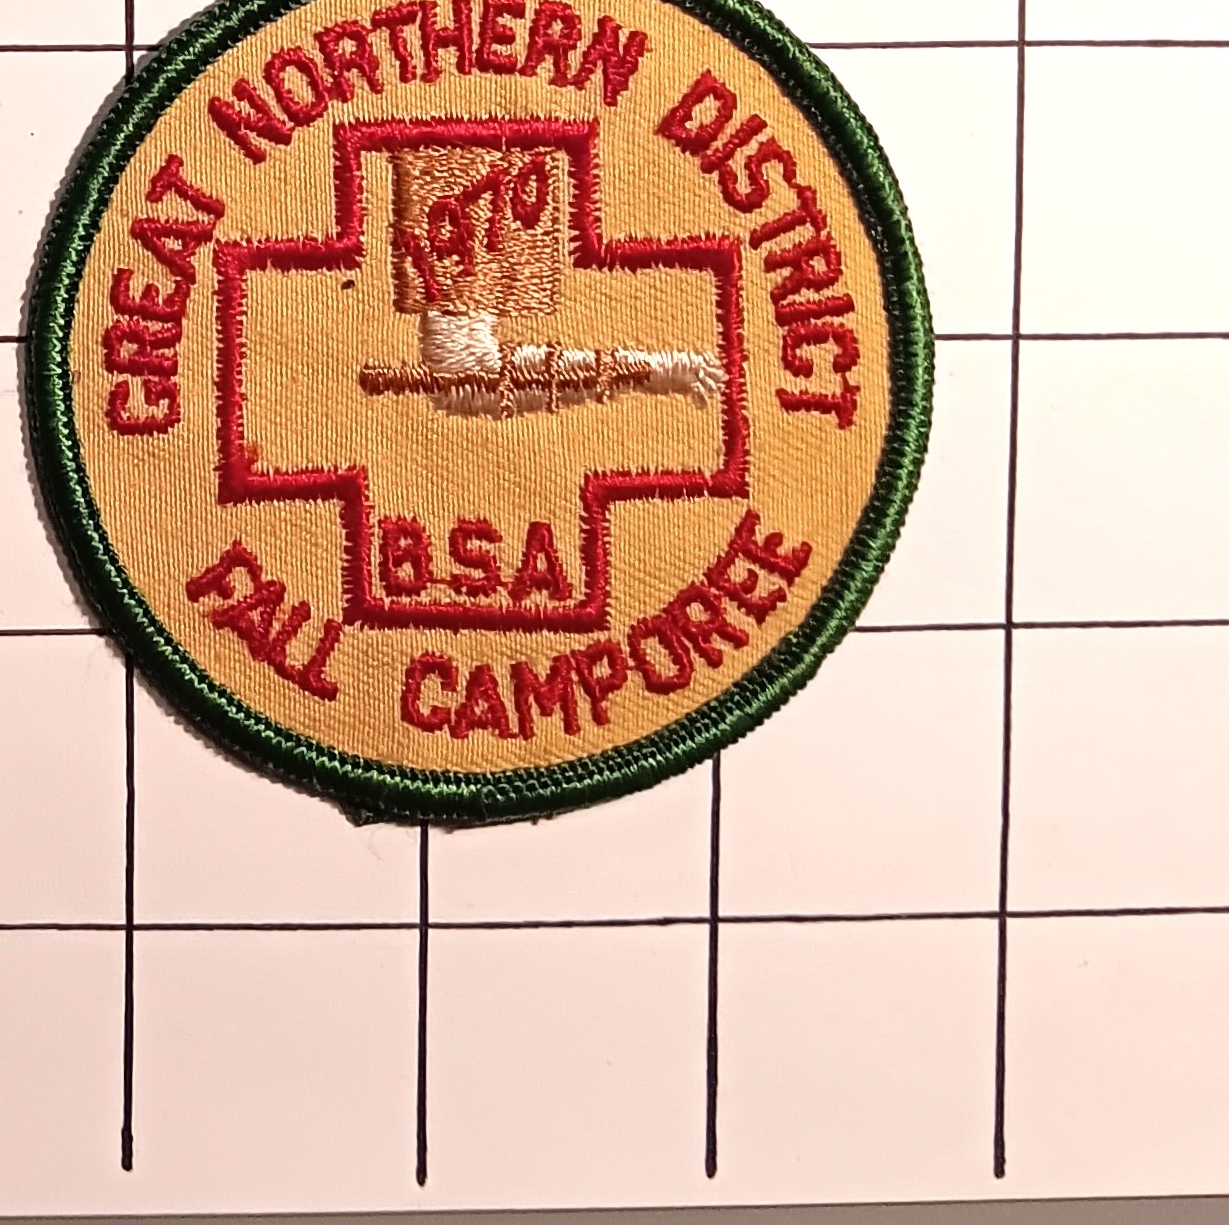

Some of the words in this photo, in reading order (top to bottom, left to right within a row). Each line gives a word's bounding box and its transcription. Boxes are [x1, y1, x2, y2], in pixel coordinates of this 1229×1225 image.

[103, 155, 225, 436] GREAT
[657, 69, 861, 430] DISTRICT
[390, 154, 547, 304] 1970
[184, 541, 343, 702] FALL
[400, 512, 812, 741] CAMPOREE
